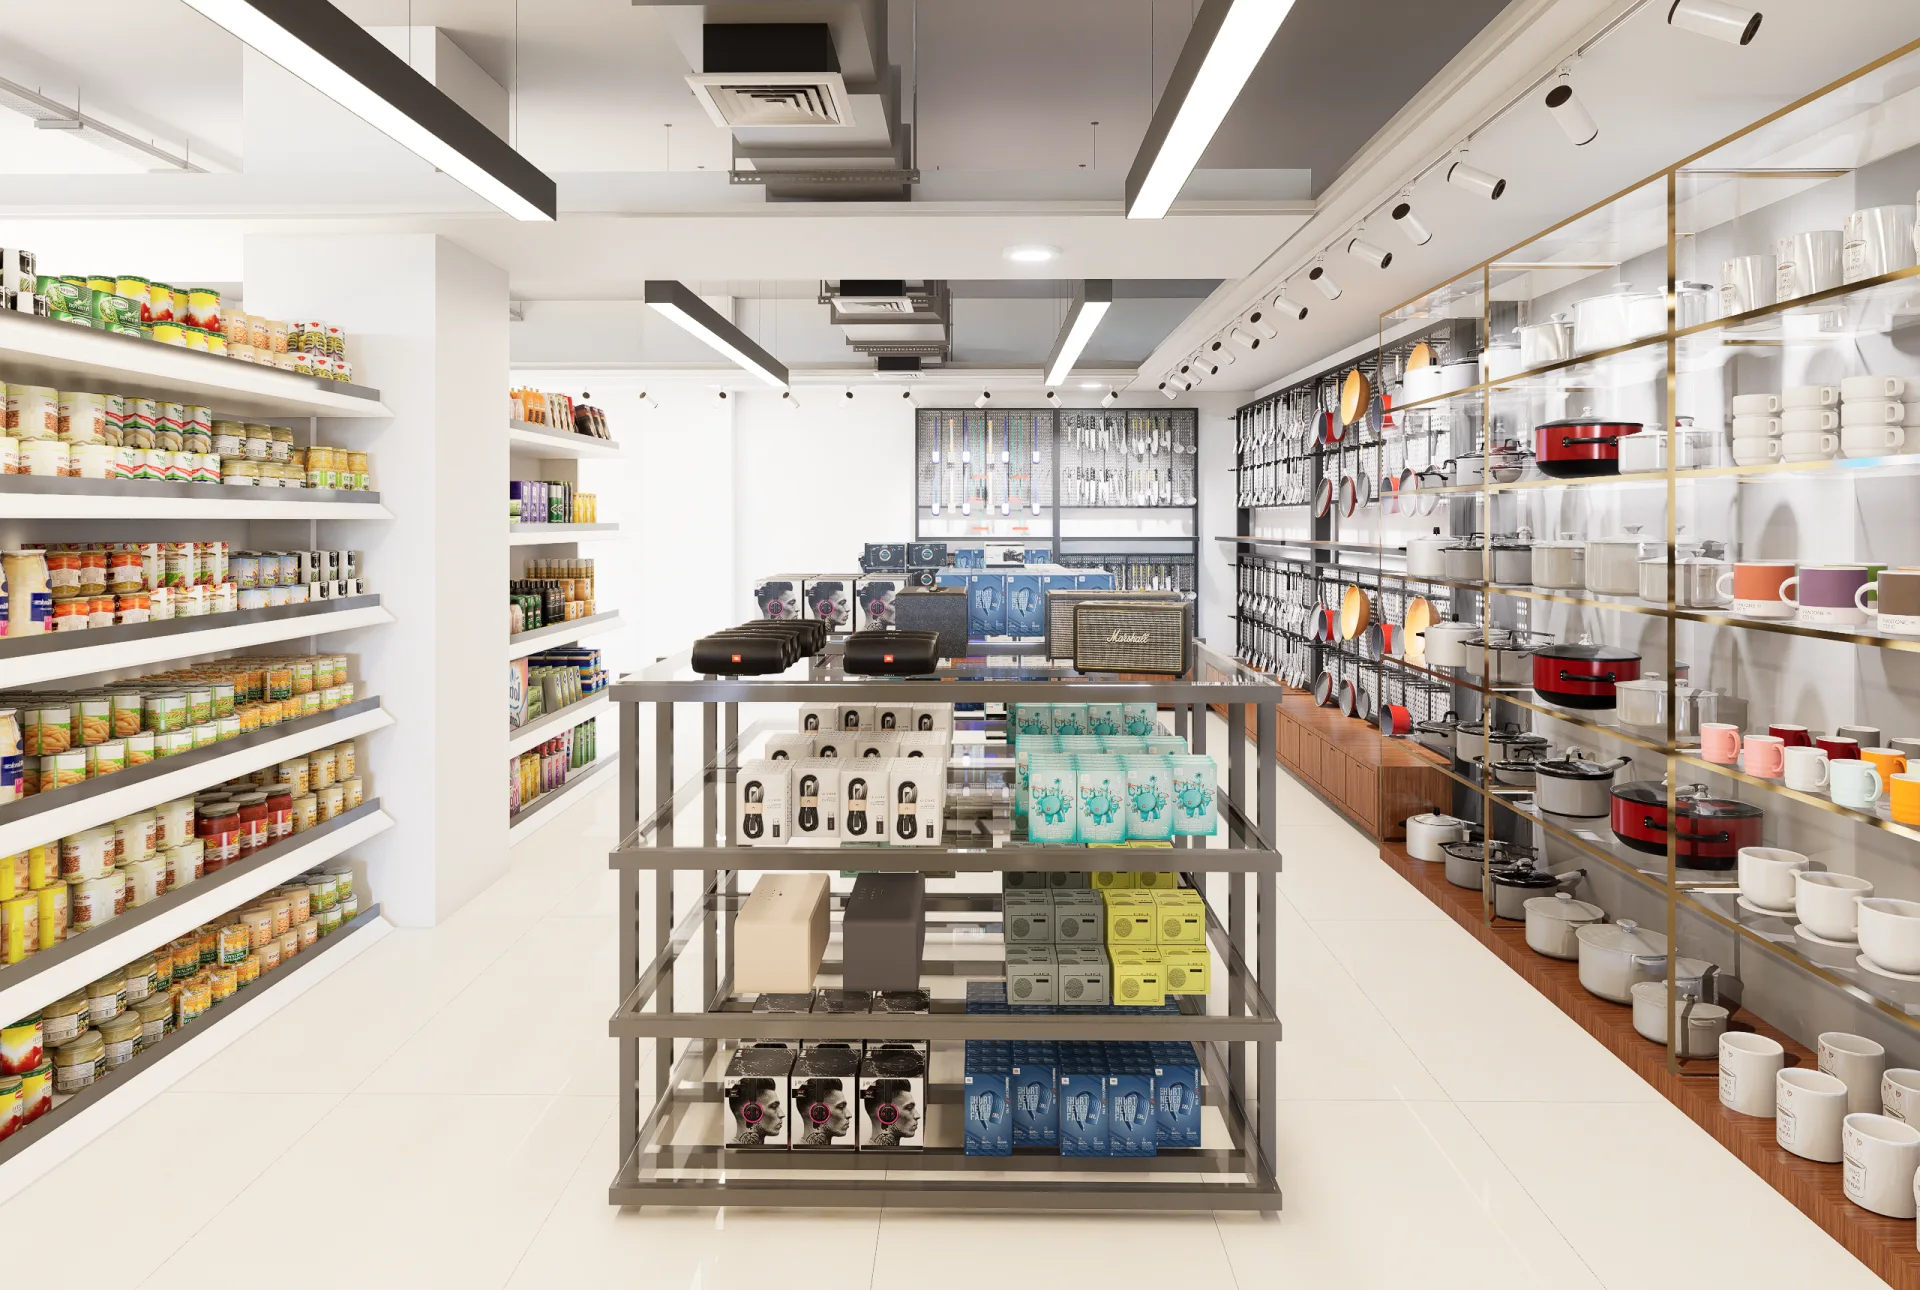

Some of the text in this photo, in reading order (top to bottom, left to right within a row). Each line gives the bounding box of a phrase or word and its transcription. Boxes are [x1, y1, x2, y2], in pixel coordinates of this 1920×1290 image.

[1106, 629, 1150, 644] Marshall
[1160, 1096, 1181, 1104] NEVER
[970, 1104, 991, 1113] NEVER
[1067, 1105, 1088, 1113] NEVER
[1067, 1113, 1086, 1121] FALL
